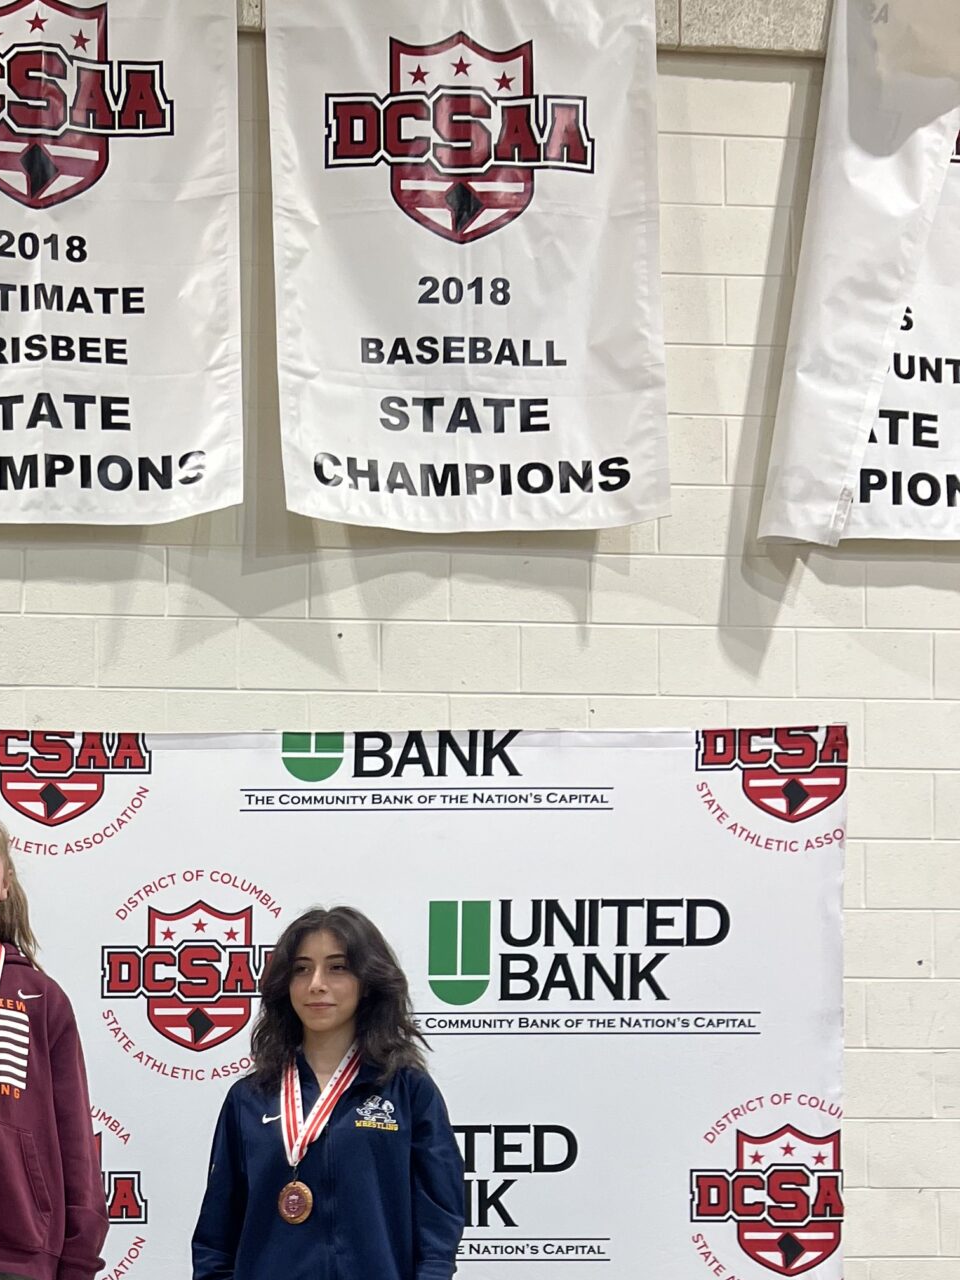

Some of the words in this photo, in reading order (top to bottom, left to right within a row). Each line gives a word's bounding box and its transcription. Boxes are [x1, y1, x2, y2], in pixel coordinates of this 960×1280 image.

[324, 85, 594, 173] DCSAA
[417, 276, 511, 306] 2018
[360, 335, 567, 367] BASEBALL
[379, 396, 551, 434] STATE
[313, 452, 631, 497] CHAMPIONS
[352, 730, 523, 778] BANK
[64, 786, 150, 855] ASSOCIATION
[696, 782, 728, 824] STATE
[728, 822, 797, 853] ATHLETIC
[114, 872, 176, 923] DISTRICT
[181, 869, 204, 884] OF
[209, 871, 282, 918] COLUMBIA
[499, 899, 730, 948] UNITED
[498, 953, 670, 1001] BANK
[102, 1010, 133, 1052] STATE
[133, 1051, 205, 1081] ATHLETIC
[354, 1120, 399, 1132] WRESTLING
[704, 1097, 764, 1144] DISTRICT
[770, 1093, 792, 1105] OF
[692, 1233, 725, 1276] STATE
